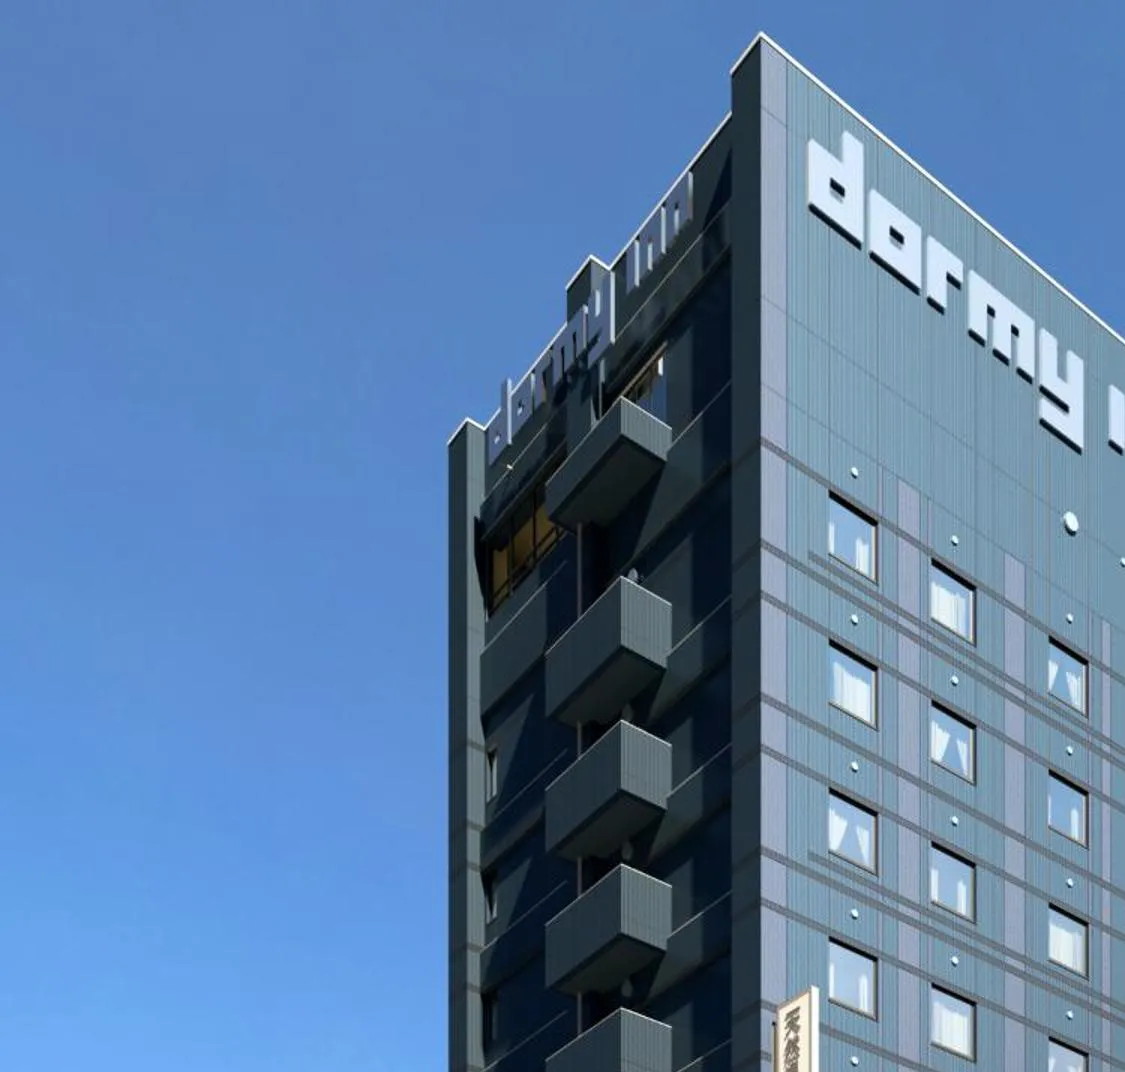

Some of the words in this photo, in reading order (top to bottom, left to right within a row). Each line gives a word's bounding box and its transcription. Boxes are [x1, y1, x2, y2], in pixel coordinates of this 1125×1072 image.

[488, 268, 616, 466] dormy
[626, 170, 694, 295] inn
[808, 130, 1085, 455] dormy
